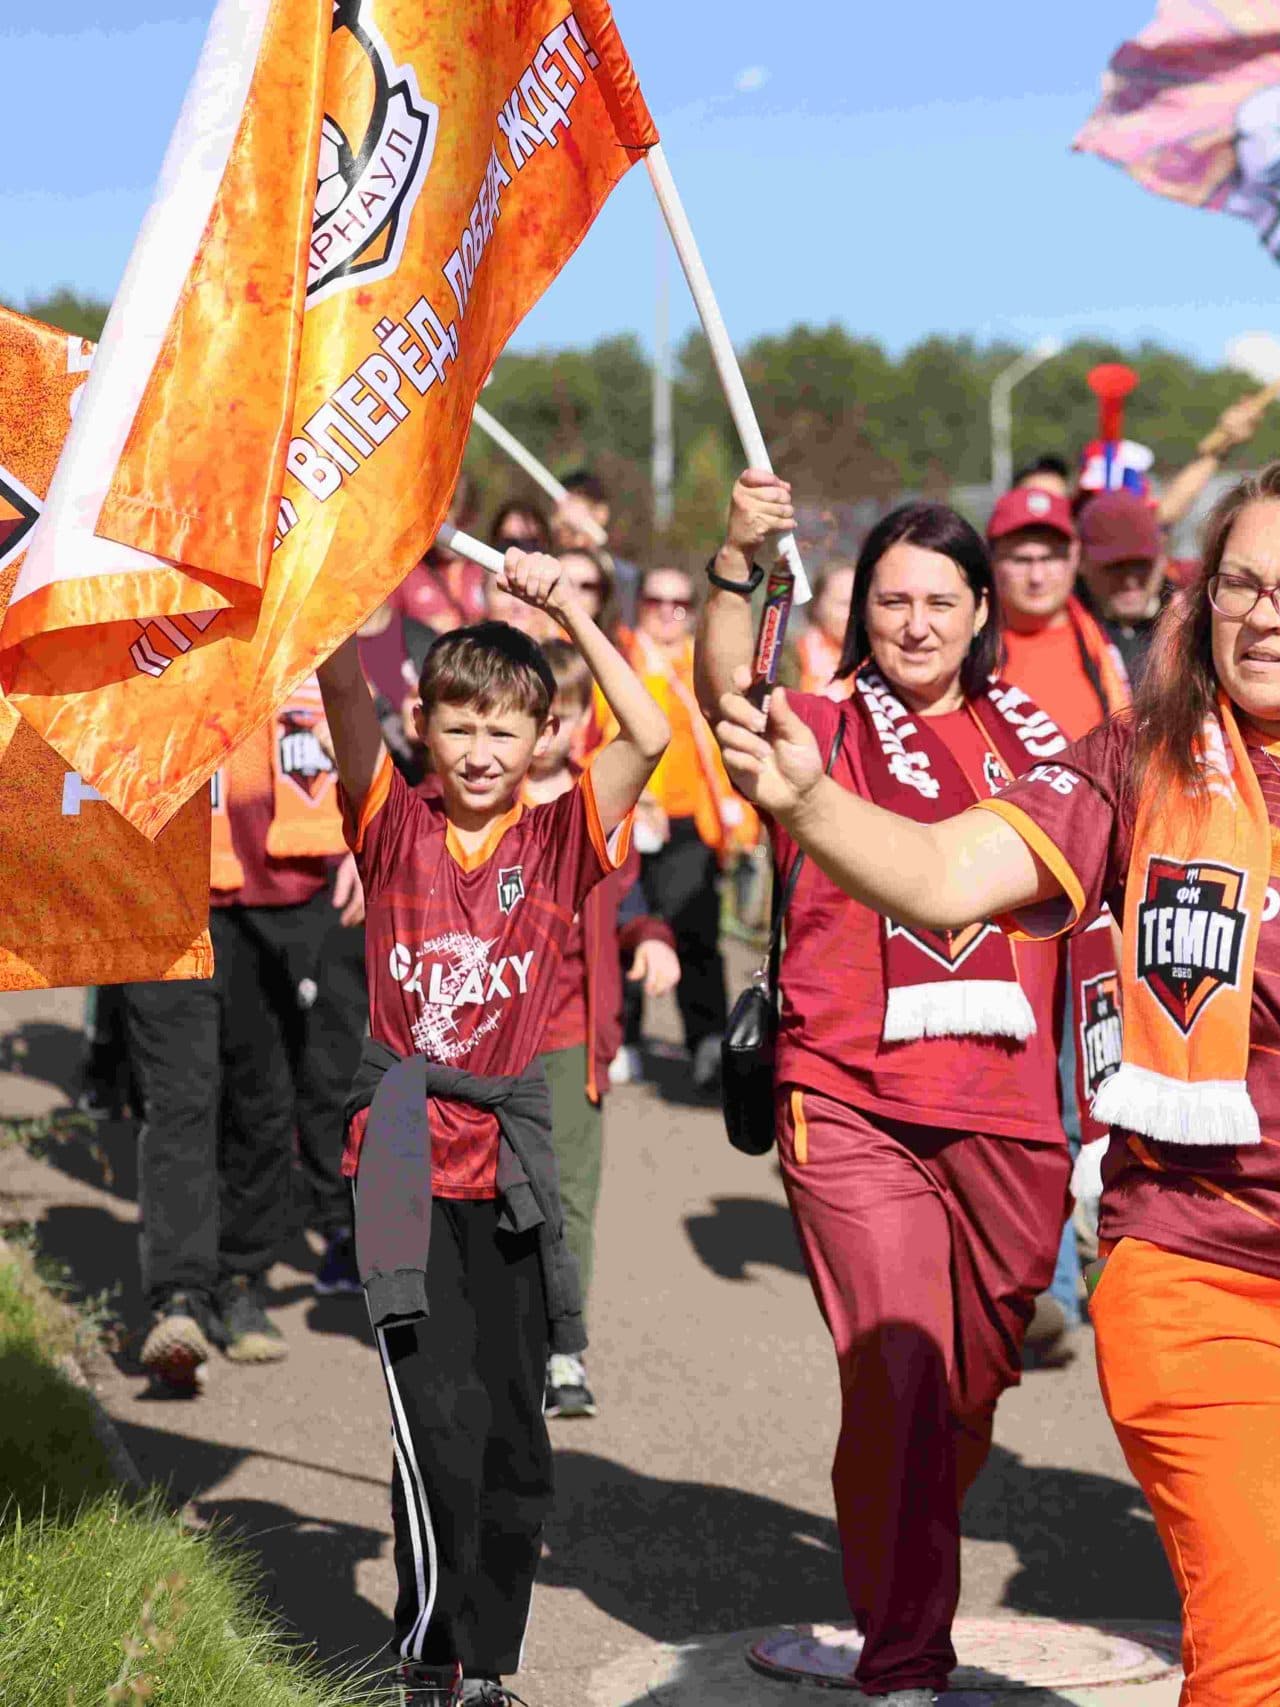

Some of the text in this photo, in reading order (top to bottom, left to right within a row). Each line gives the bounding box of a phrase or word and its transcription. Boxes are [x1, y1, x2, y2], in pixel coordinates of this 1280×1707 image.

[287, 13, 600, 502] ВПЕРЁД, ПОБЕДА ЖДЕТ!
[1176, 886, 1201, 904] ФК
[1143, 906, 1236, 972] ТЕМП
[389, 942, 535, 1007] GALAXY
[1171, 966, 1193, 979] 2020
